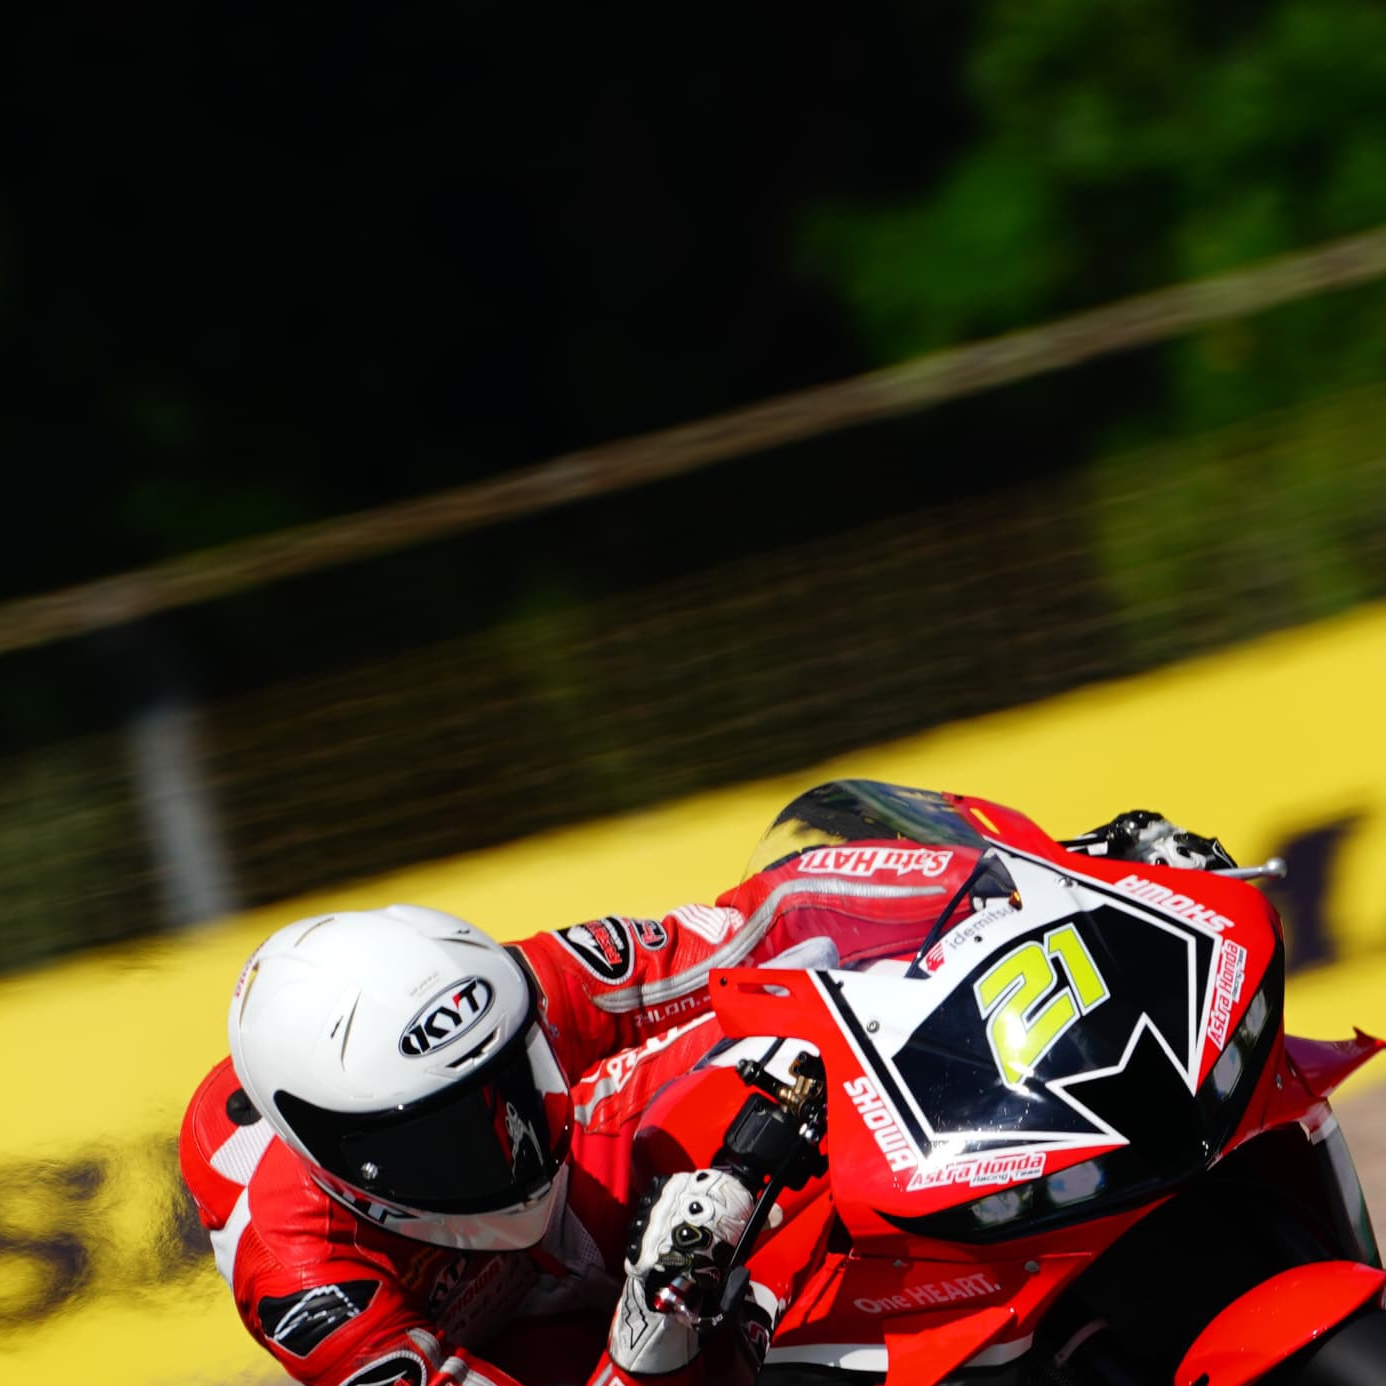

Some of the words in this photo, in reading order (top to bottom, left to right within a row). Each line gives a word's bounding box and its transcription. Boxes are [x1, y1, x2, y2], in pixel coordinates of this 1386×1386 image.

[1114, 875, 1234, 932] SHOWA
[1218, 940, 1240, 994] Honda
[408, 980, 480, 1054] KYT
[973, 922, 1111, 1092] 21
[1210, 995, 1231, 1046] Astra
[843, 1077, 916, 1172] SHOWA
[912, 1165, 970, 1187] Astra
[975, 1154, 1043, 1176] Honda
[853, 1291, 912, 1313] One
[905, 1273, 1002, 1305] HEART.
